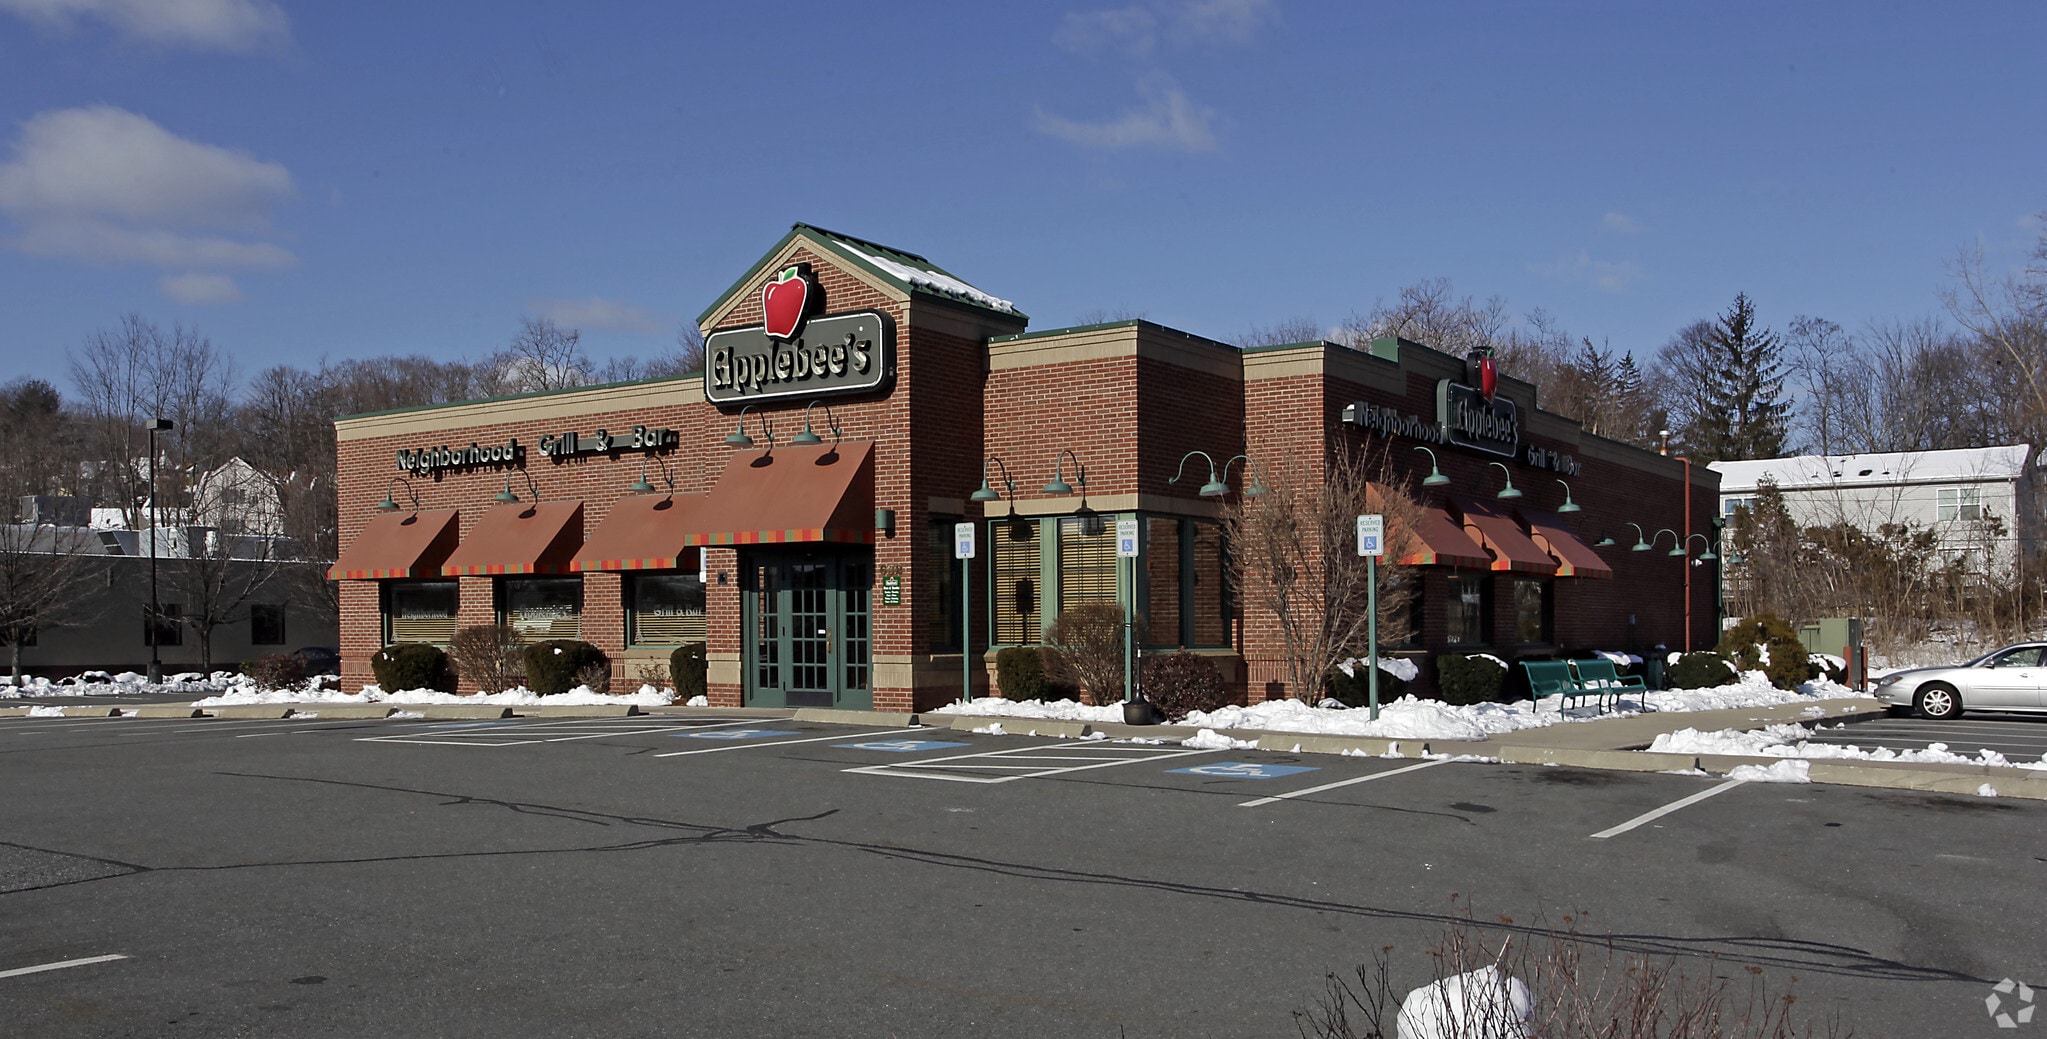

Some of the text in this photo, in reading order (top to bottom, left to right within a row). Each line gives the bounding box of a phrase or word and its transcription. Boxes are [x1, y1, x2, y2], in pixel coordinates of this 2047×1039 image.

[712, 333, 872, 392] Applebee's
[1358, 401, 1444, 445] Neighborhood
[1458, 398, 1519, 445] Applebee's
[396, 425, 669, 474] Neighborhood Grill & Bar
[1527, 444, 1546, 469] Grill
[1567, 455, 1582, 477] Bar
